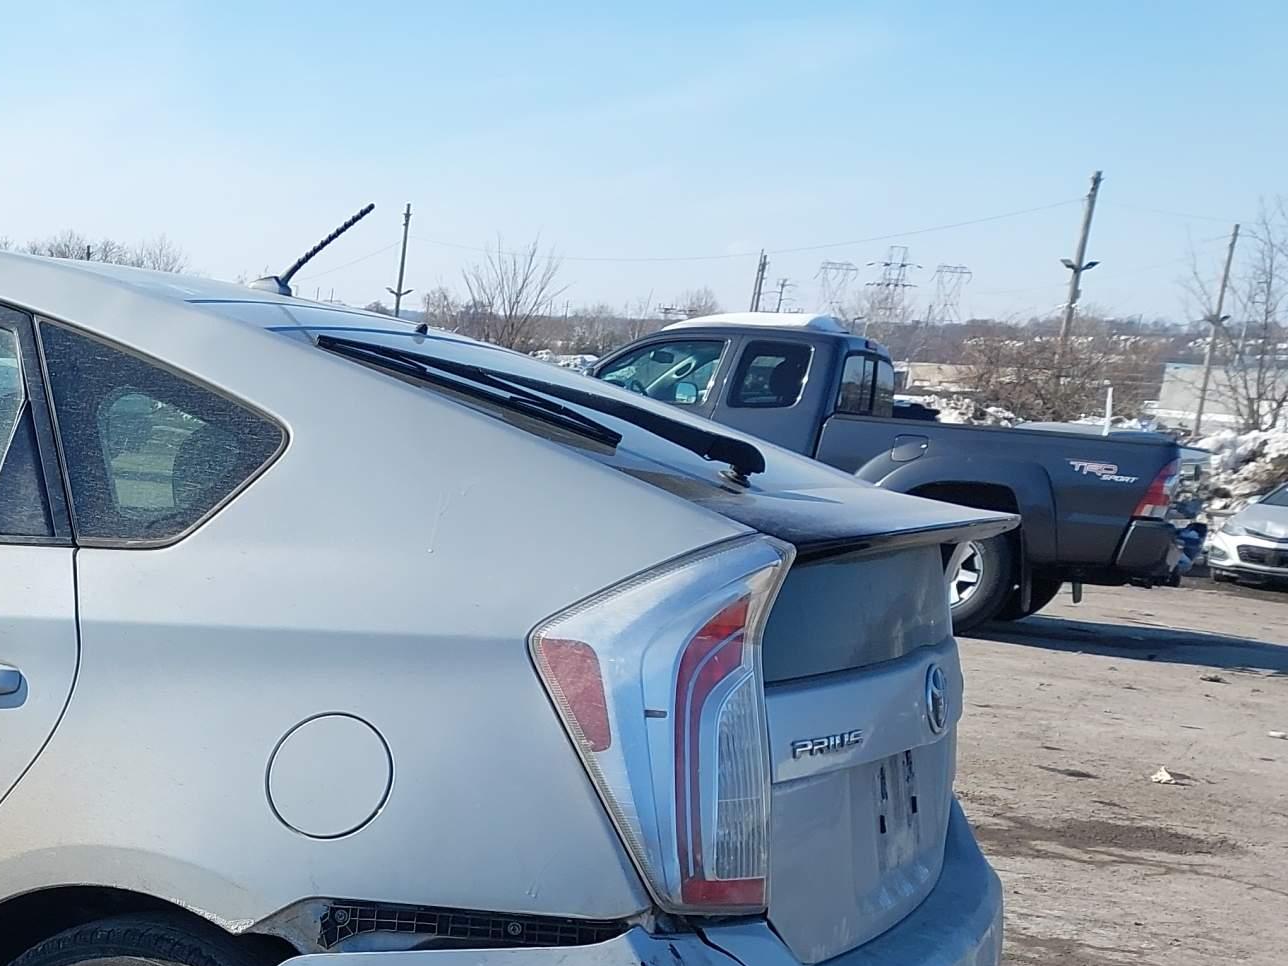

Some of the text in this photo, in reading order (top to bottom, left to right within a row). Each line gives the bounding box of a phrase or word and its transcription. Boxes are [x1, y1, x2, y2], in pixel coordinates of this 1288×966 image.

[1069, 461, 1118, 475] TRD
[1099, 474, 1139, 483] SPORT
[790, 728, 864, 759] PRIUS
